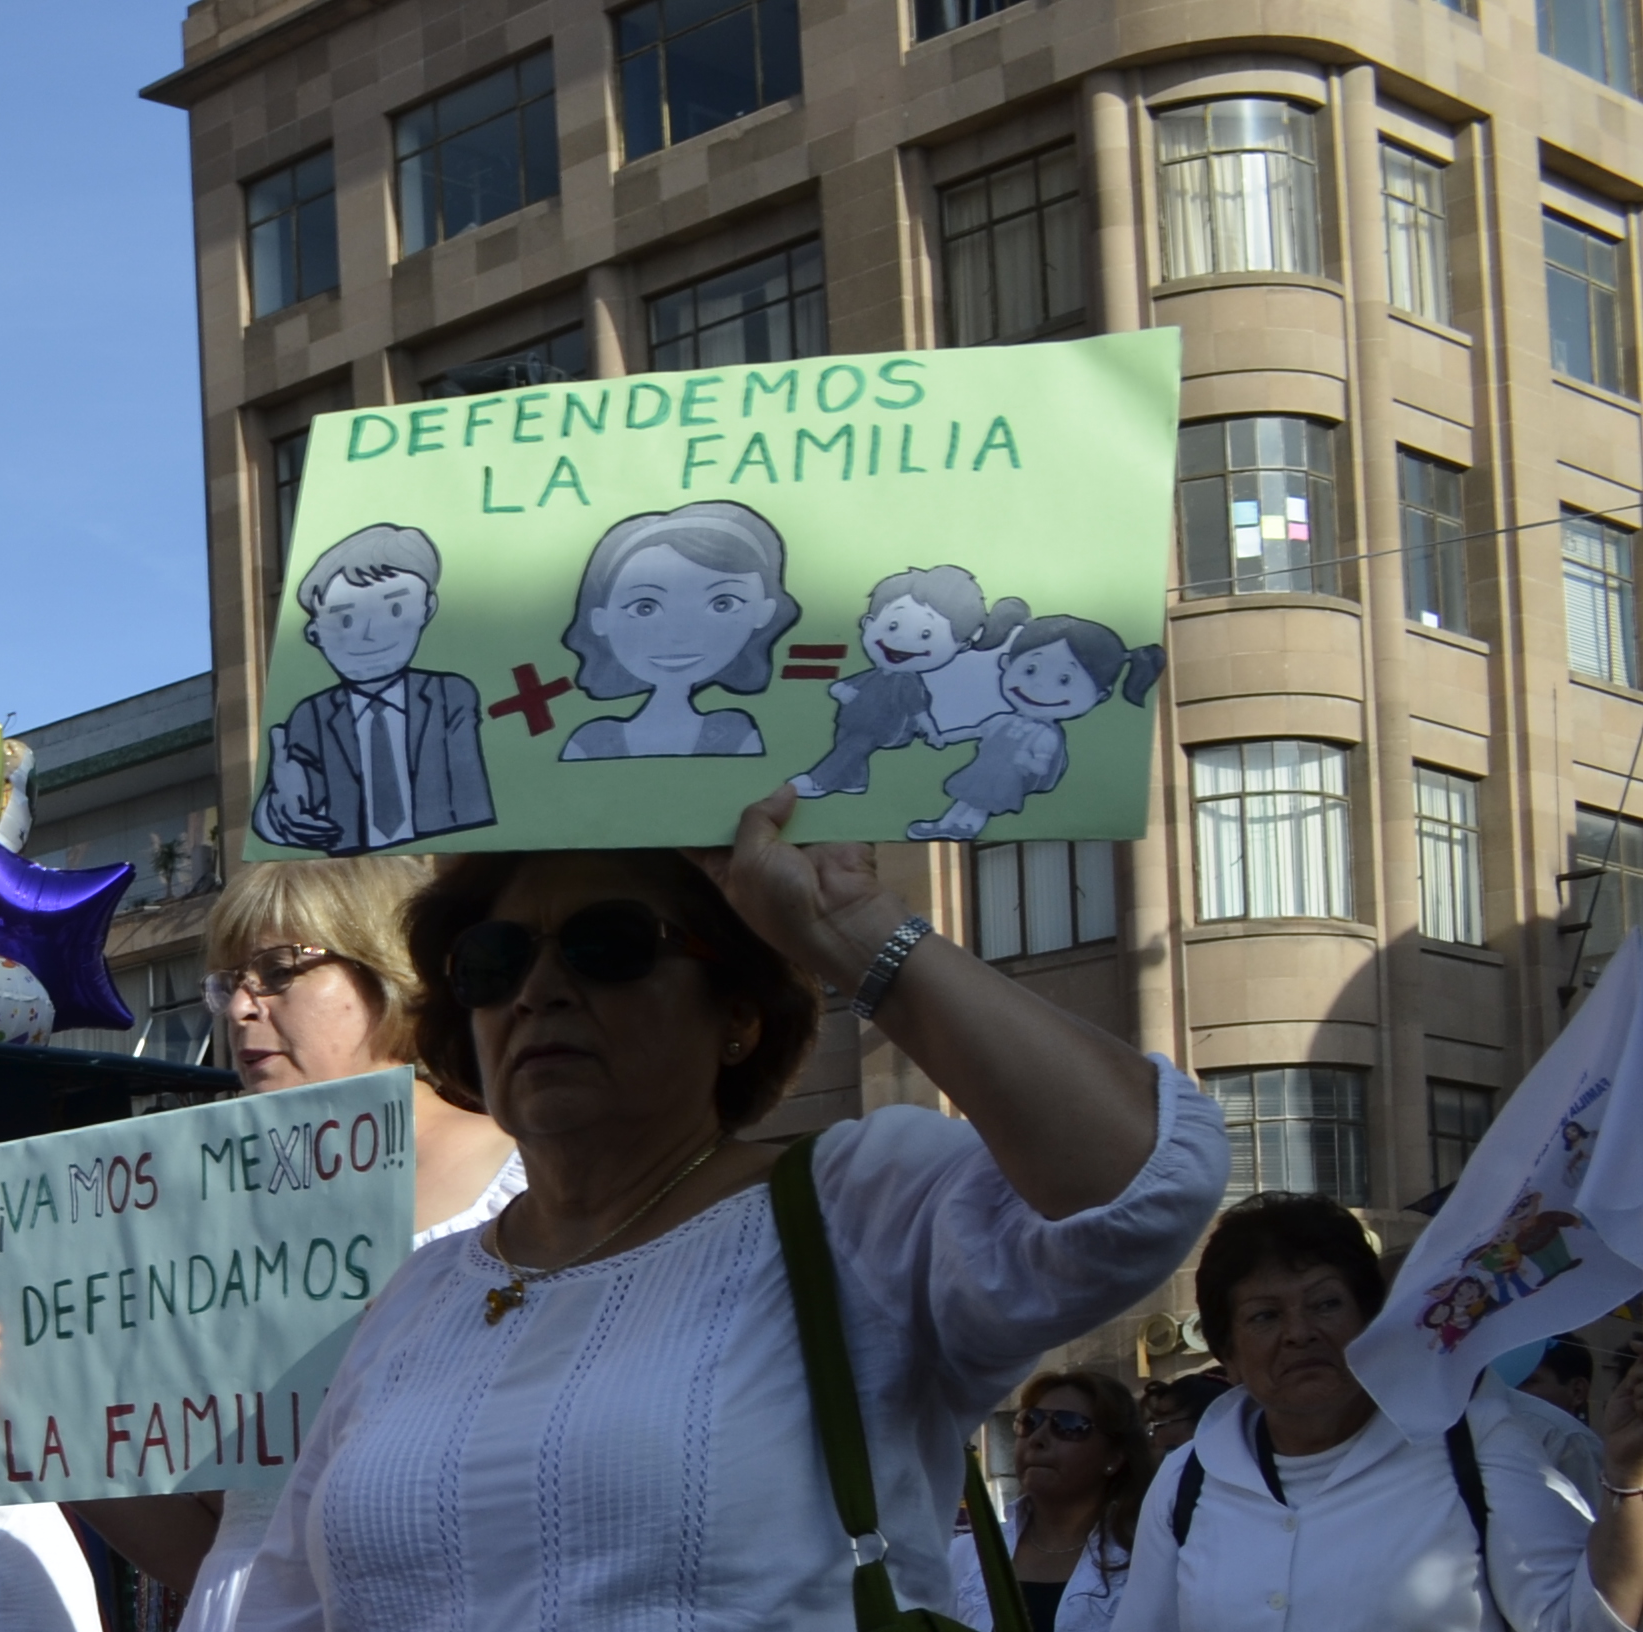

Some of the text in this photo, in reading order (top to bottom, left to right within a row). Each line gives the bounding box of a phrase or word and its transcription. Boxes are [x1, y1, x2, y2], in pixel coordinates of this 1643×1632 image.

[346, 358, 927, 463] DEFENDEMOS
[481, 415, 1022, 514] LA FAMILIA
[200, 1099, 406, 1201] MEXICO!!!
[21, 1234, 373, 1346] DEFENDAMOS
[4, 1386, 330, 1482] LA FAMILI
